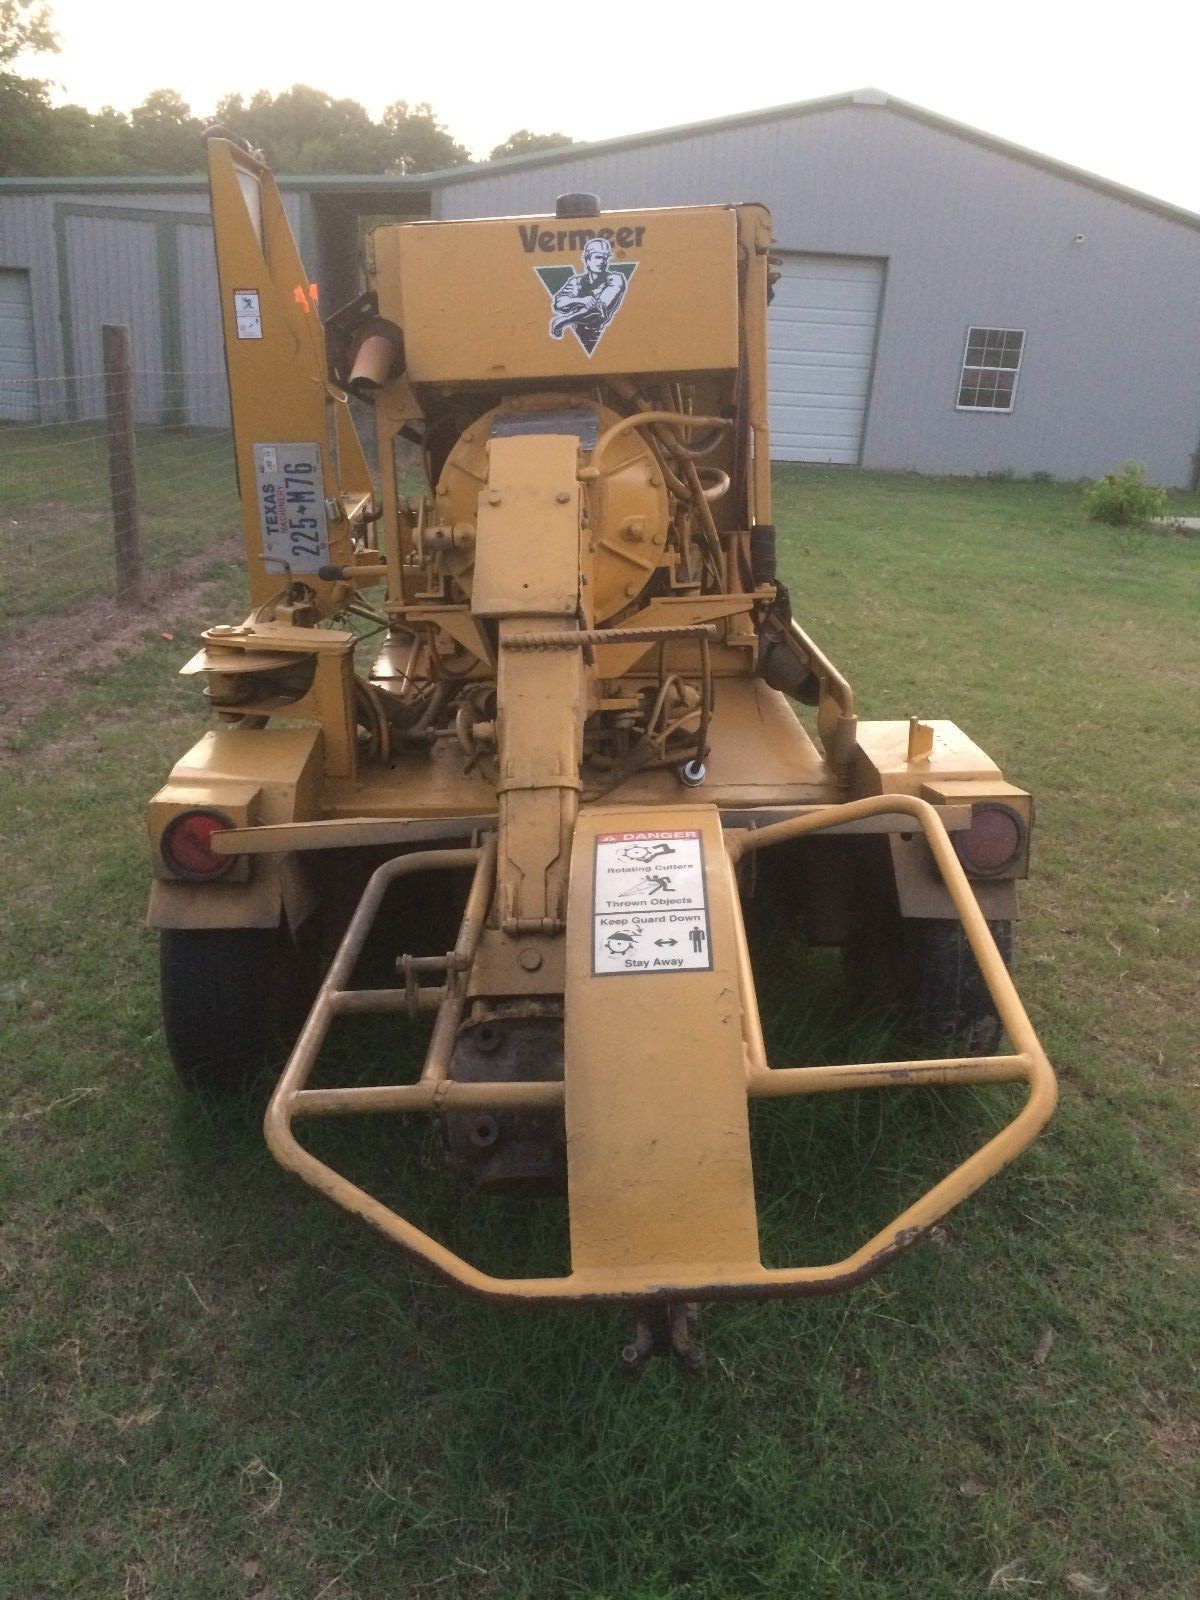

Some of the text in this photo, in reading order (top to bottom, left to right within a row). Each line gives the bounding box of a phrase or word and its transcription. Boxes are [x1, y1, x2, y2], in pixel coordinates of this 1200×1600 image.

[518, 224, 646, 252] Vermeer
[262, 483, 279, 535] TEXAS
[277, 487, 288, 533] MACHINERY
[623, 831, 697, 841] DANGER
[607, 865, 652, 874] Rotating
[606, 897, 693, 908] Thrown Objects
[600, 918, 629, 926] Keep
[632, 916, 666, 924] Guard
[625, 958, 684, 968] Stay Away
